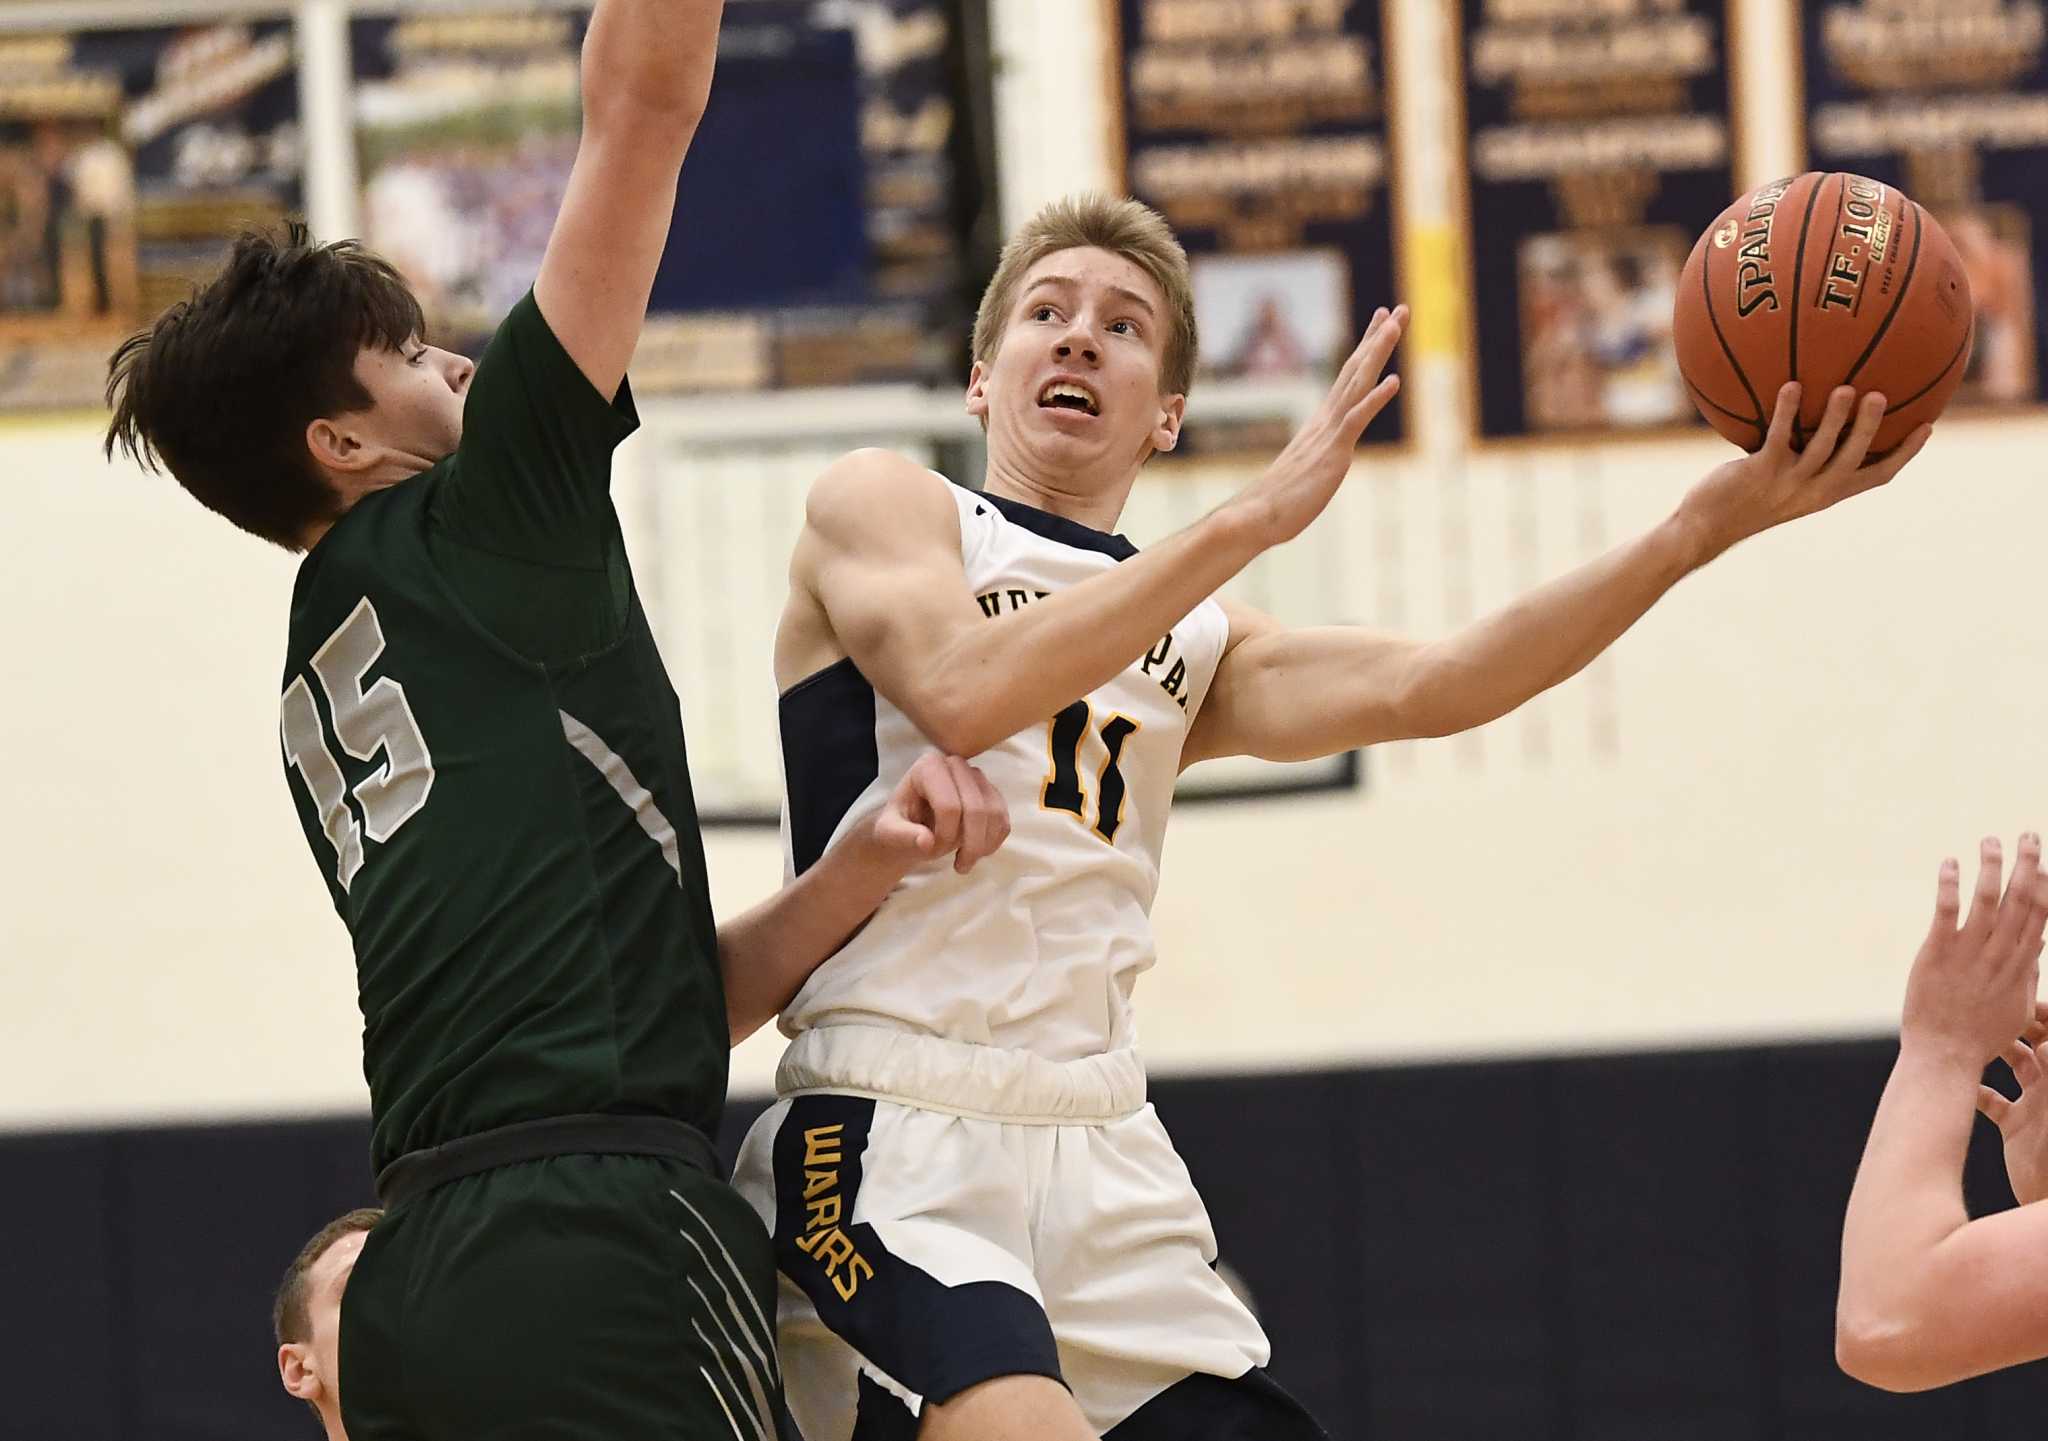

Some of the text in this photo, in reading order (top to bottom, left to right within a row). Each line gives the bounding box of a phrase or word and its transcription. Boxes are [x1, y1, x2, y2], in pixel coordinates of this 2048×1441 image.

[1737, 176, 1795, 318] SPALDI
[280, 595, 435, 895] 15
[1039, 698, 1143, 846] 11
